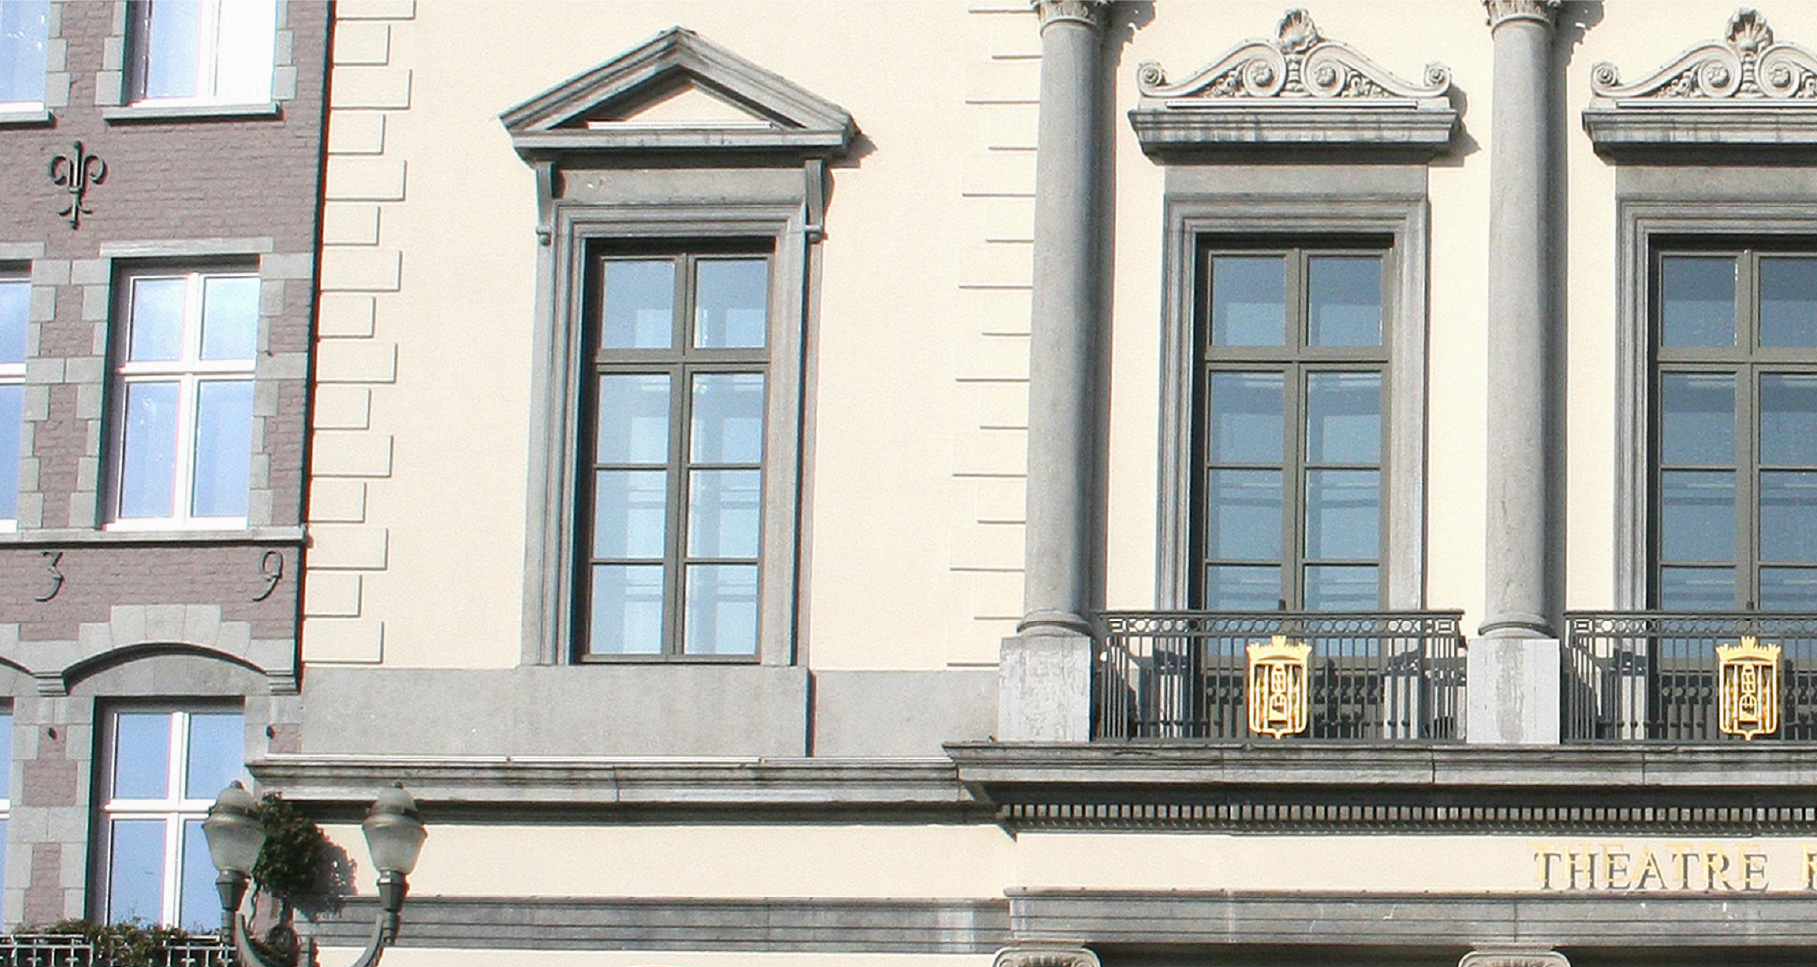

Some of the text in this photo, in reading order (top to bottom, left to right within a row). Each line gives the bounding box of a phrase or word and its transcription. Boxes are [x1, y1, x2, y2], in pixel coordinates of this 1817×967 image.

[34, 550, 284, 602] 3 9
[1530, 842, 1767, 888] THEATRE
